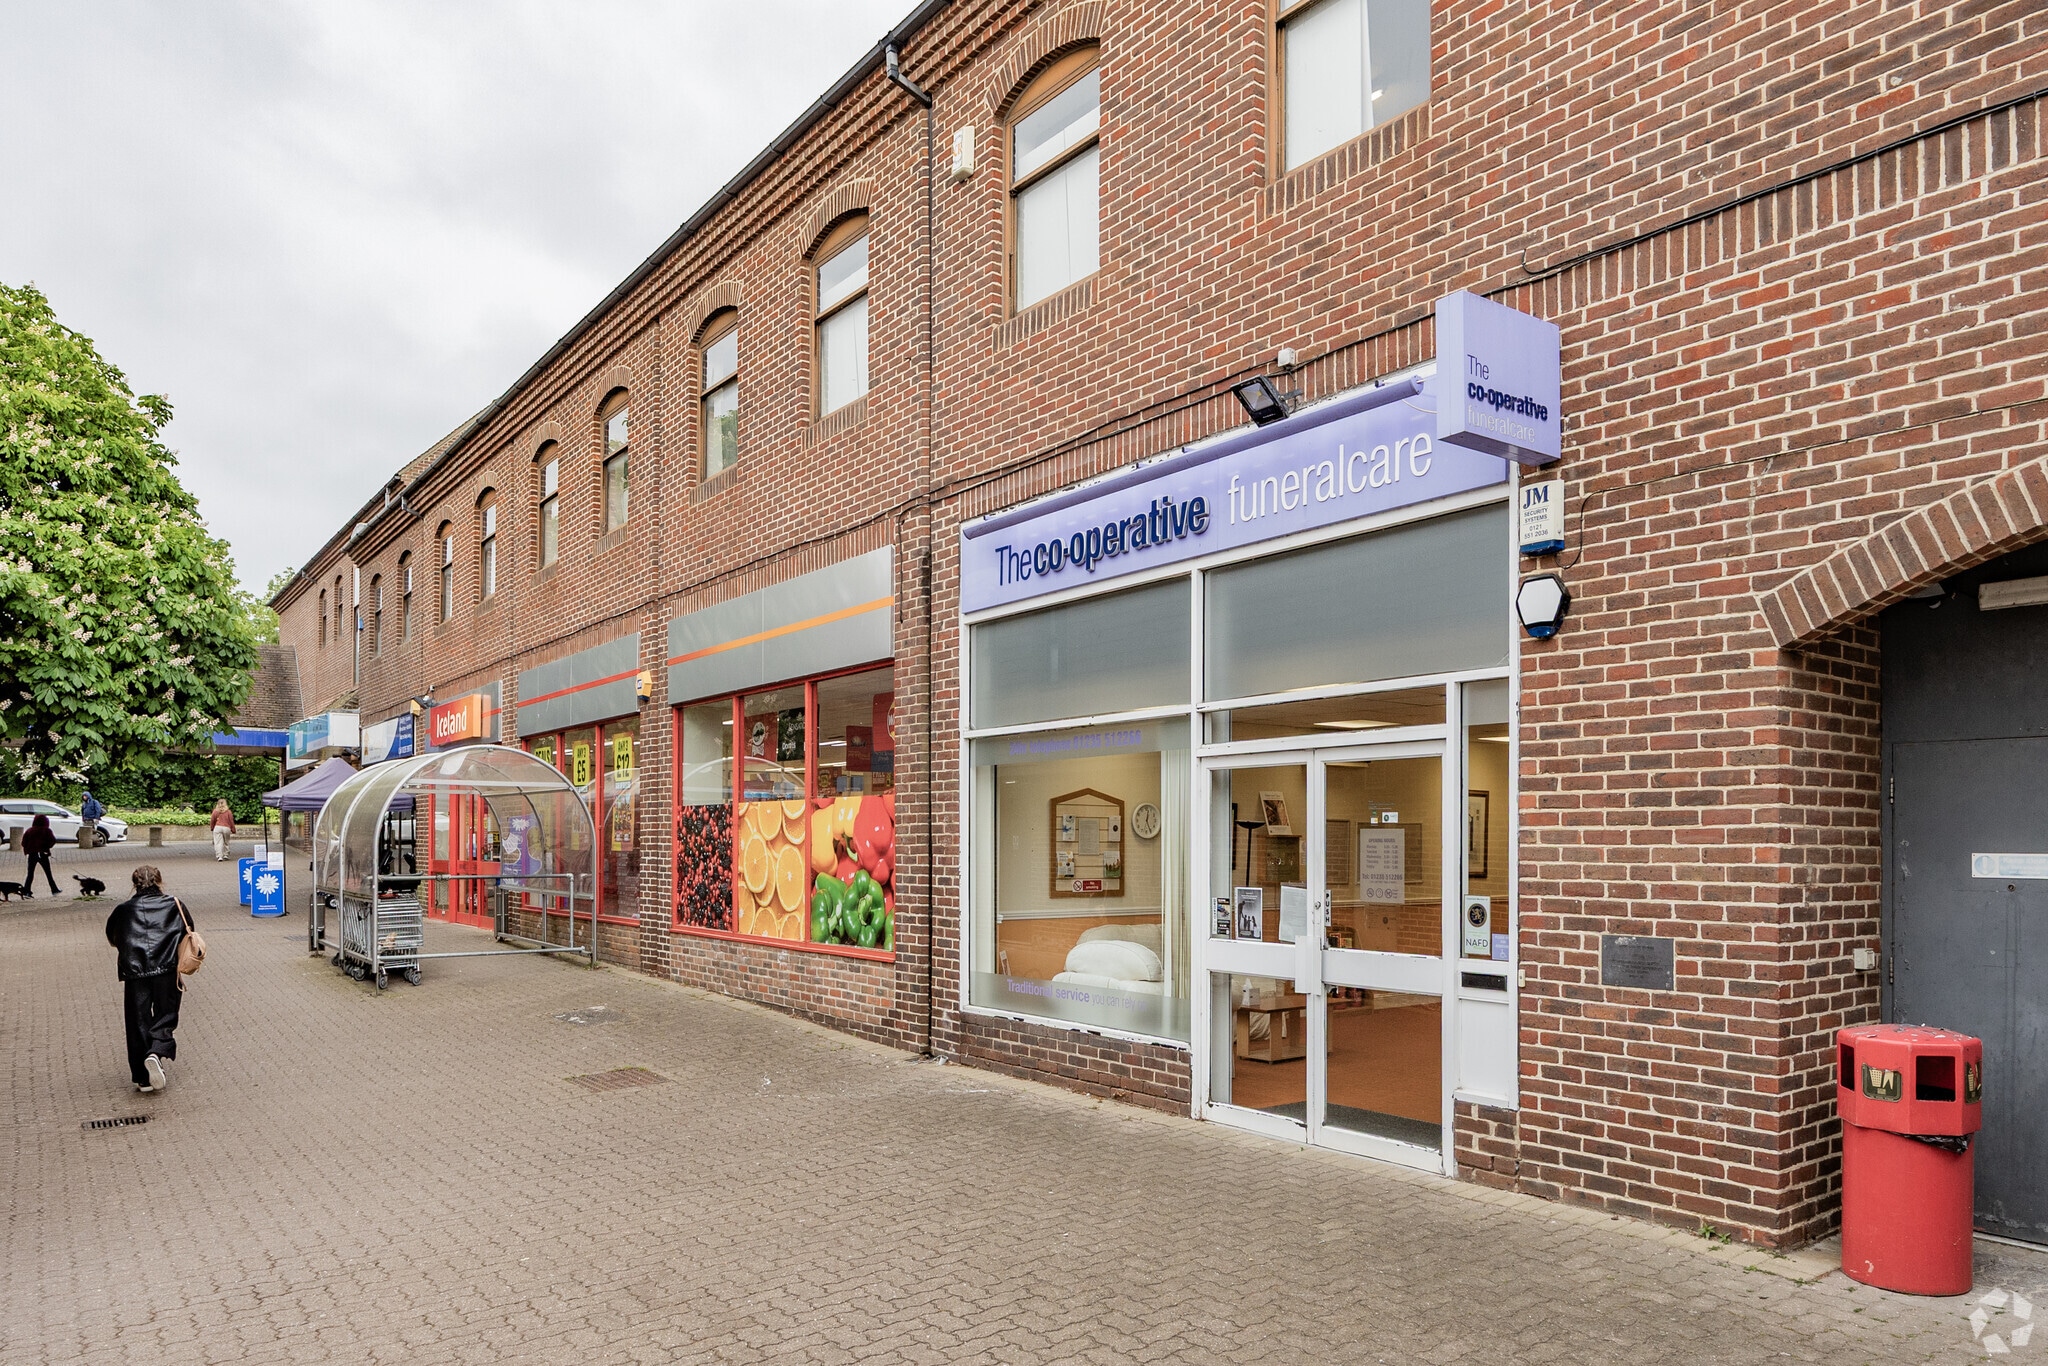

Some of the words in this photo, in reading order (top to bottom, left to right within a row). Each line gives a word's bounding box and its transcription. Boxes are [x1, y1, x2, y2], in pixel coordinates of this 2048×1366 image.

[1467, 354, 1490, 380] The
[1467, 382, 1549, 422] co-operative
[1468, 405, 1536, 443] funeralcare
[1523, 484, 1549, 509] JM
[995, 544, 1032, 587] The
[1033, 494, 1211, 576] co-operative
[1227, 432, 1433, 525] funeralcare
[1524, 508, 1549, 518] SECURITY
[1524, 514, 1548, 524] SYSTEMS
[1529, 524, 1542, 532] 0121
[436, 706, 467, 738] Iceland
[577, 760, 586, 783] £5
[1466, 938, 1488, 947] NAFD
[1007, 979, 1053, 997] Traditional
[1056, 988, 1090, 1003] service
[1092, 994, 1105, 1006] you
[1107, 996, 1120, 1007] can
